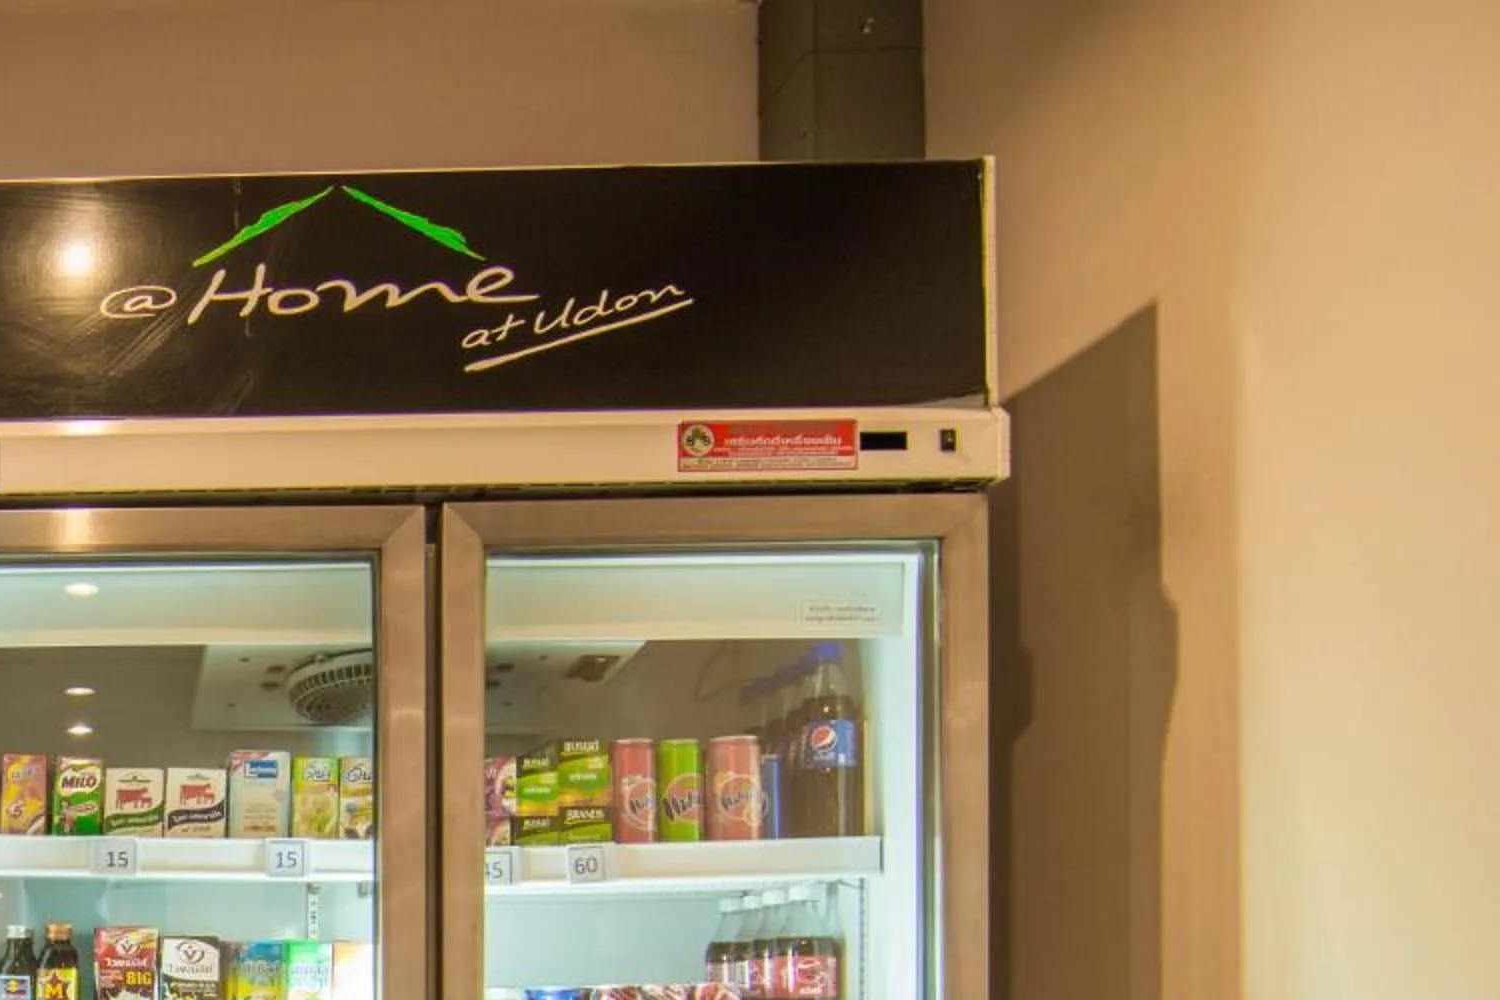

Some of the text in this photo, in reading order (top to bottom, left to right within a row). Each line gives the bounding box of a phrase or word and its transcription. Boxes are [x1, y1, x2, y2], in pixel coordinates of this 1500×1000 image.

[187, 263, 540, 325] Home
[461, 284, 686, 350] at Udon
[61, 774, 97, 789] MILO
[106, 851, 130, 868] 15
[275, 851, 298, 869] 15
[574, 857, 598, 875] 60
[126, 970, 153, 986] BIG
